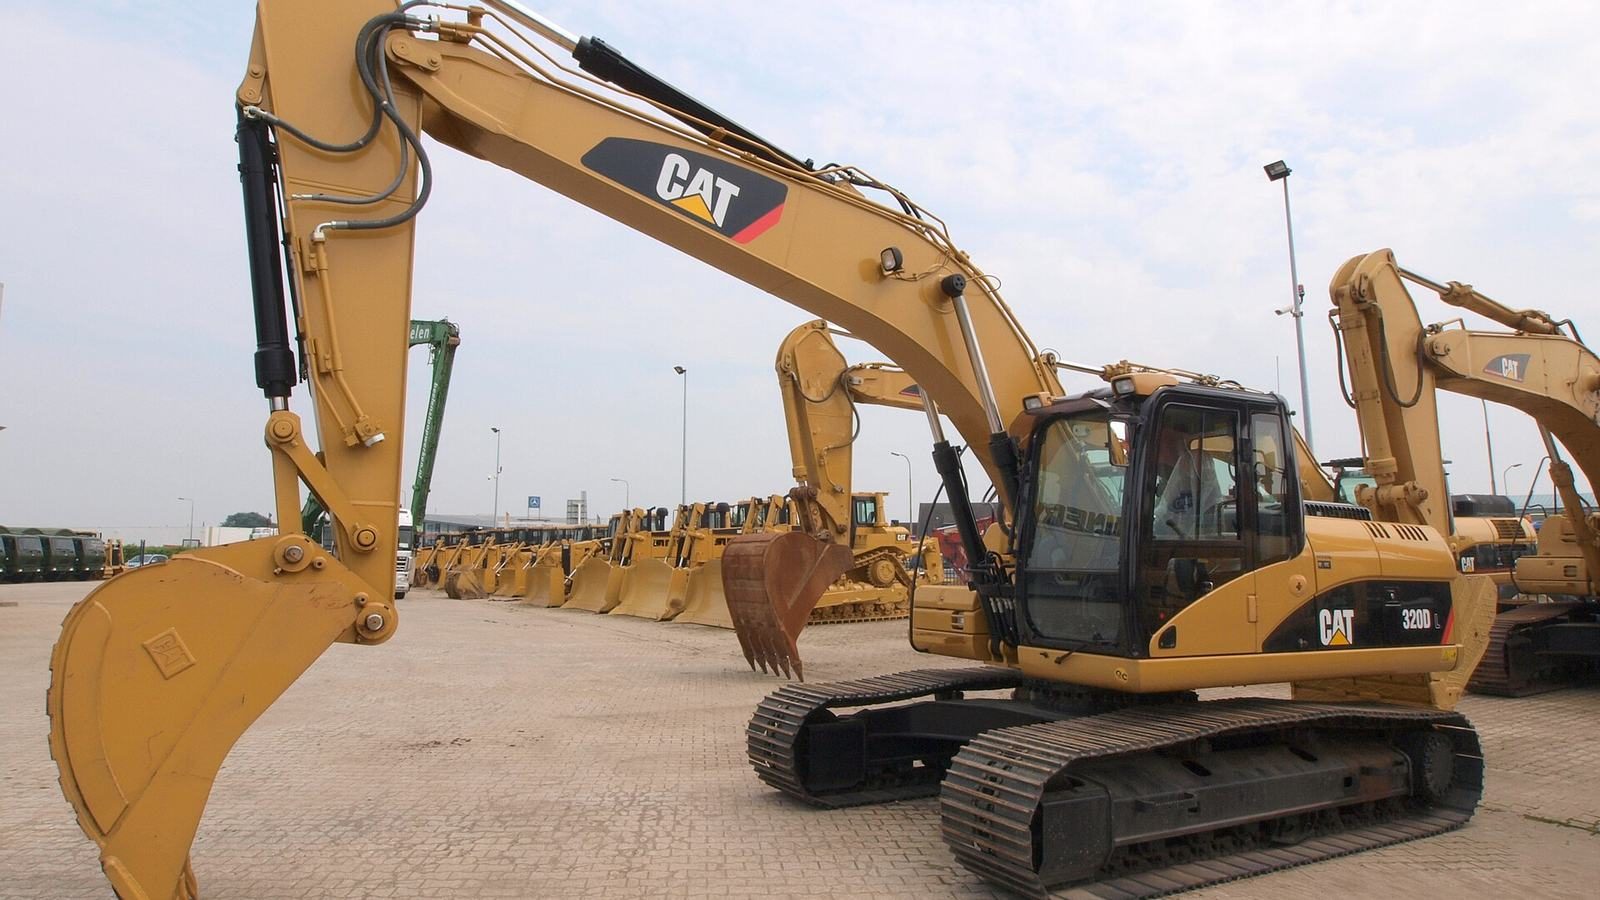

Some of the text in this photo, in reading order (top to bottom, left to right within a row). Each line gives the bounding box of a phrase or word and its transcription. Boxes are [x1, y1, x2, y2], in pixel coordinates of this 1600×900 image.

[656, 153, 741, 228] CAT
[1502, 357, 1518, 380] CAT
[1461, 556, 1475, 573] CAT
[1319, 608, 1355, 646] CAT
[1402, 608, 1431, 630] 320D
